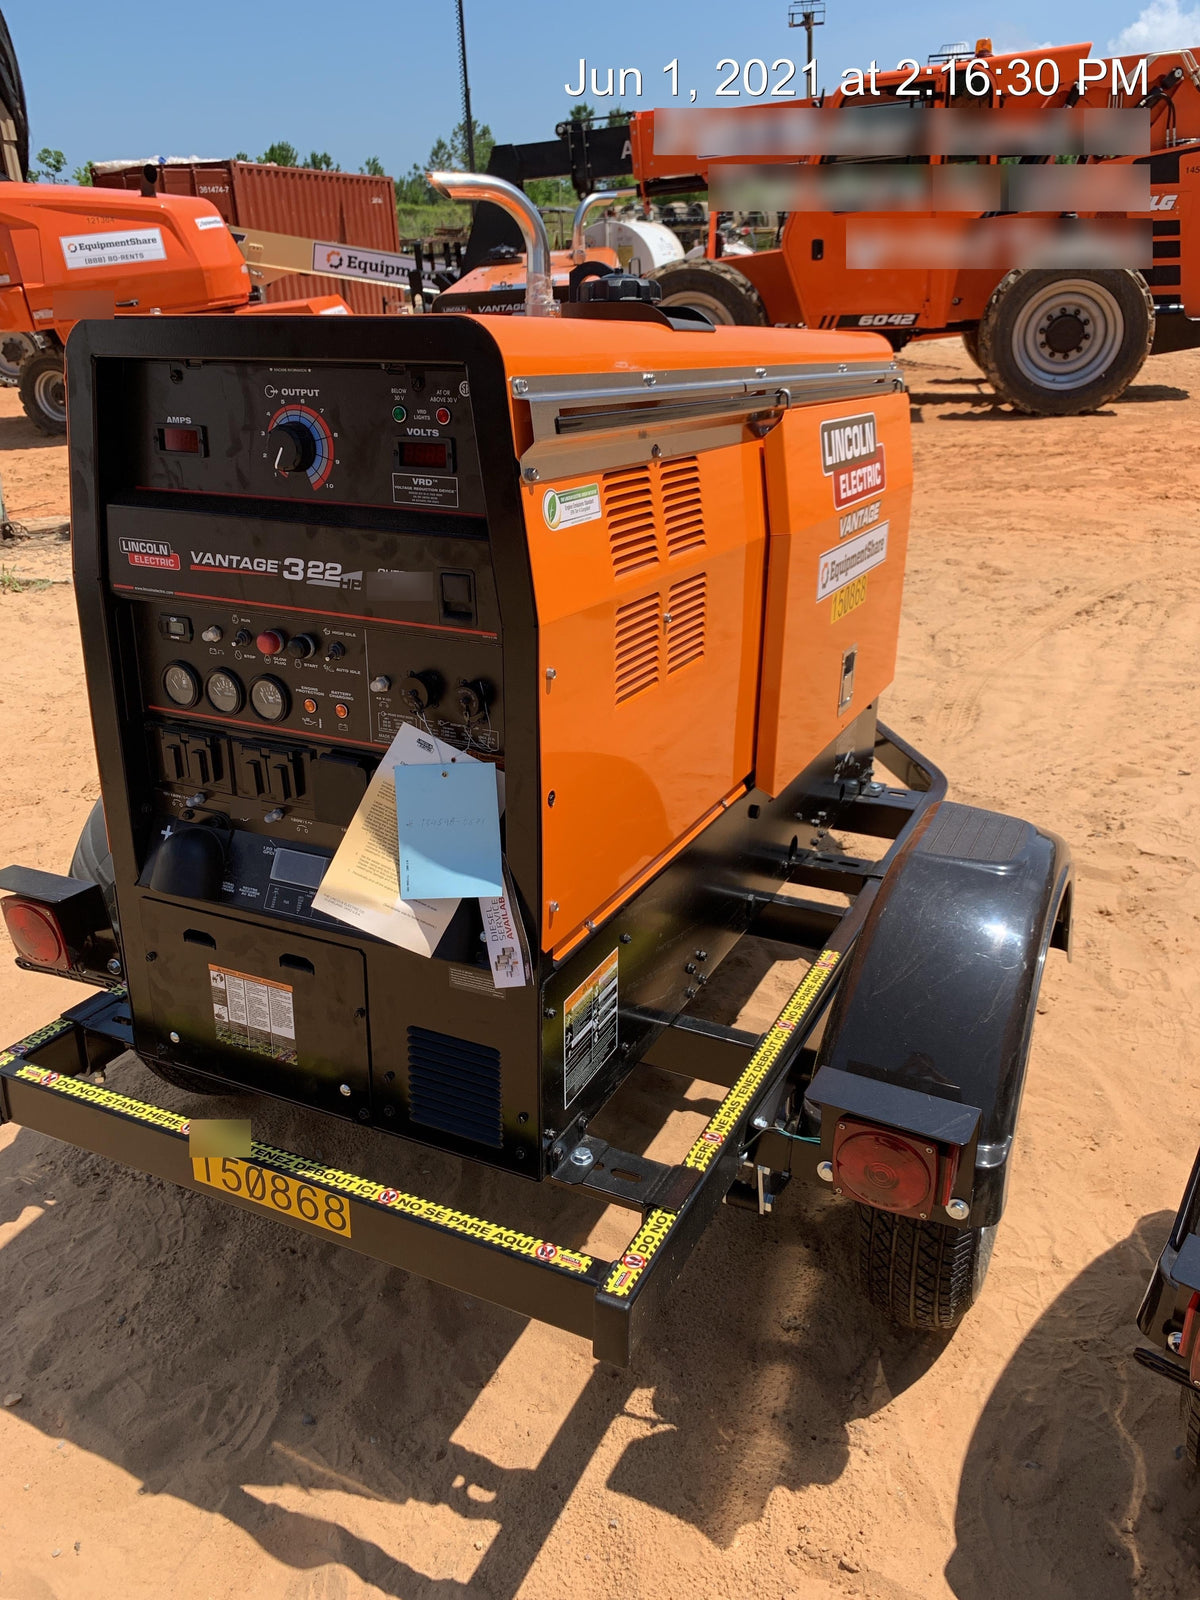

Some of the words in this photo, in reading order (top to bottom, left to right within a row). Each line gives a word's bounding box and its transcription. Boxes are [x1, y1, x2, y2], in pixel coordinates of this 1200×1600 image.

[78, 236, 158, 252] EquipmentShare
[858, 314, 916, 326] 6042
[281, 388, 320, 397] OUTPUT
[166, 416, 192, 425] AMPS
[406, 428, 440, 437] VOLTS
[823, 421, 875, 466] LINCOLN
[839, 462, 882, 500] ELECTRIC
[839, 501, 882, 539] VANTAGE
[121, 539, 169, 555] LINCOLN
[134, 554, 176, 567] ELECTRIC
[829, 537, 885, 582] EquipmentShare
[190, 550, 279, 573] VANTAGE
[282, 557, 342, 581] 322
[832, 574, 867, 621] 150868
[491, 908, 500, 942] DIESEL
[497, 898, 507, 941] SERVICE
[786, 1010, 797, 1022] NO
[794, 999, 804, 1011] SE
[799, 981, 815, 1001] PARE
[715, 1113, 729, 1132] NE
[723, 1100, 741, 1122] PAS
[736, 1072, 757, 1103] TENEZ
[753, 1039, 777, 1074] DEBOUT
[773, 1030, 786, 1045] ICI
[55, 1079, 74, 1090] DO
[76, 1086, 102, 1099] NOT
[102, 1095, 146, 1115] STAND
[146, 1109, 184, 1128] HERE
[294, 1160, 356, 1186] DEBOUT
[355, 1183, 379, 1196] ICI
[398, 1198, 422, 1212] NO
[423, 1206, 443, 1219] SE
[442, 1213, 491, 1238] PARE
[635, 1235, 656, 1254] DO
